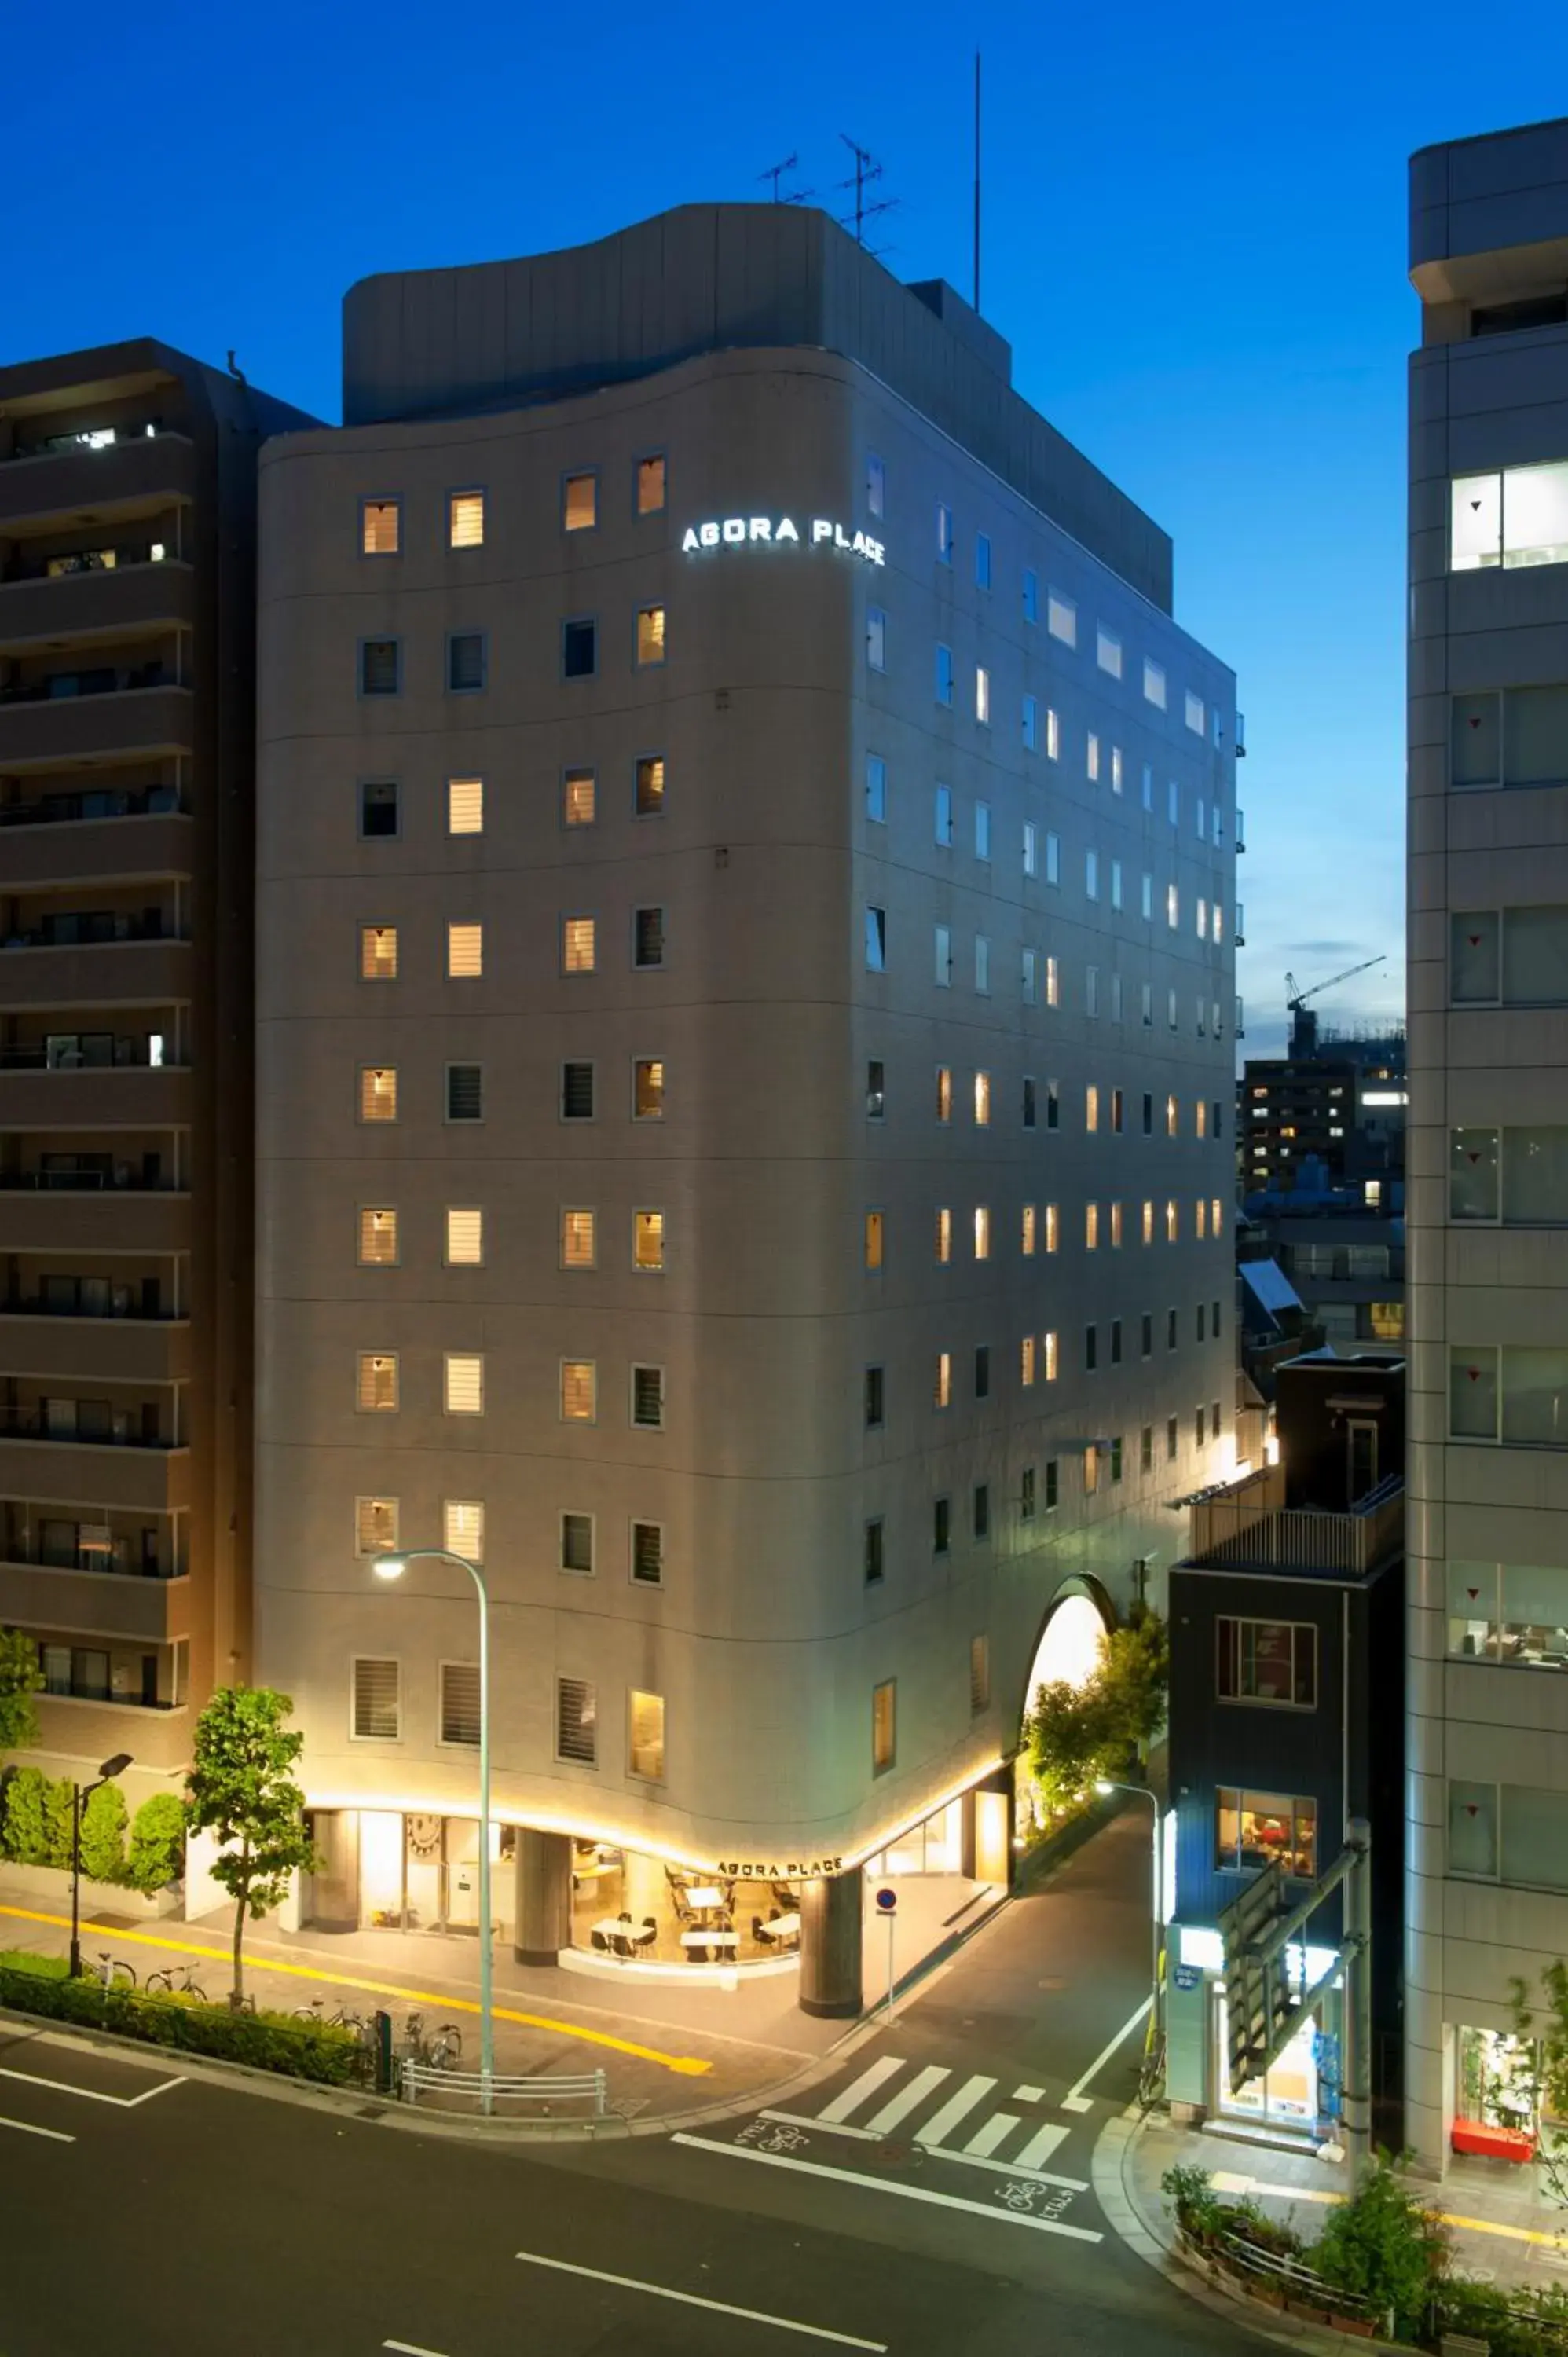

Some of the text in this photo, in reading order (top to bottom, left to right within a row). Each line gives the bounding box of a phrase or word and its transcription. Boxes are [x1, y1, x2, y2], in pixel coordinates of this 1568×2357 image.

[682, 518, 885, 566] AGORA PLACE
[718, 1857, 843, 1877] AGORA PLACE
